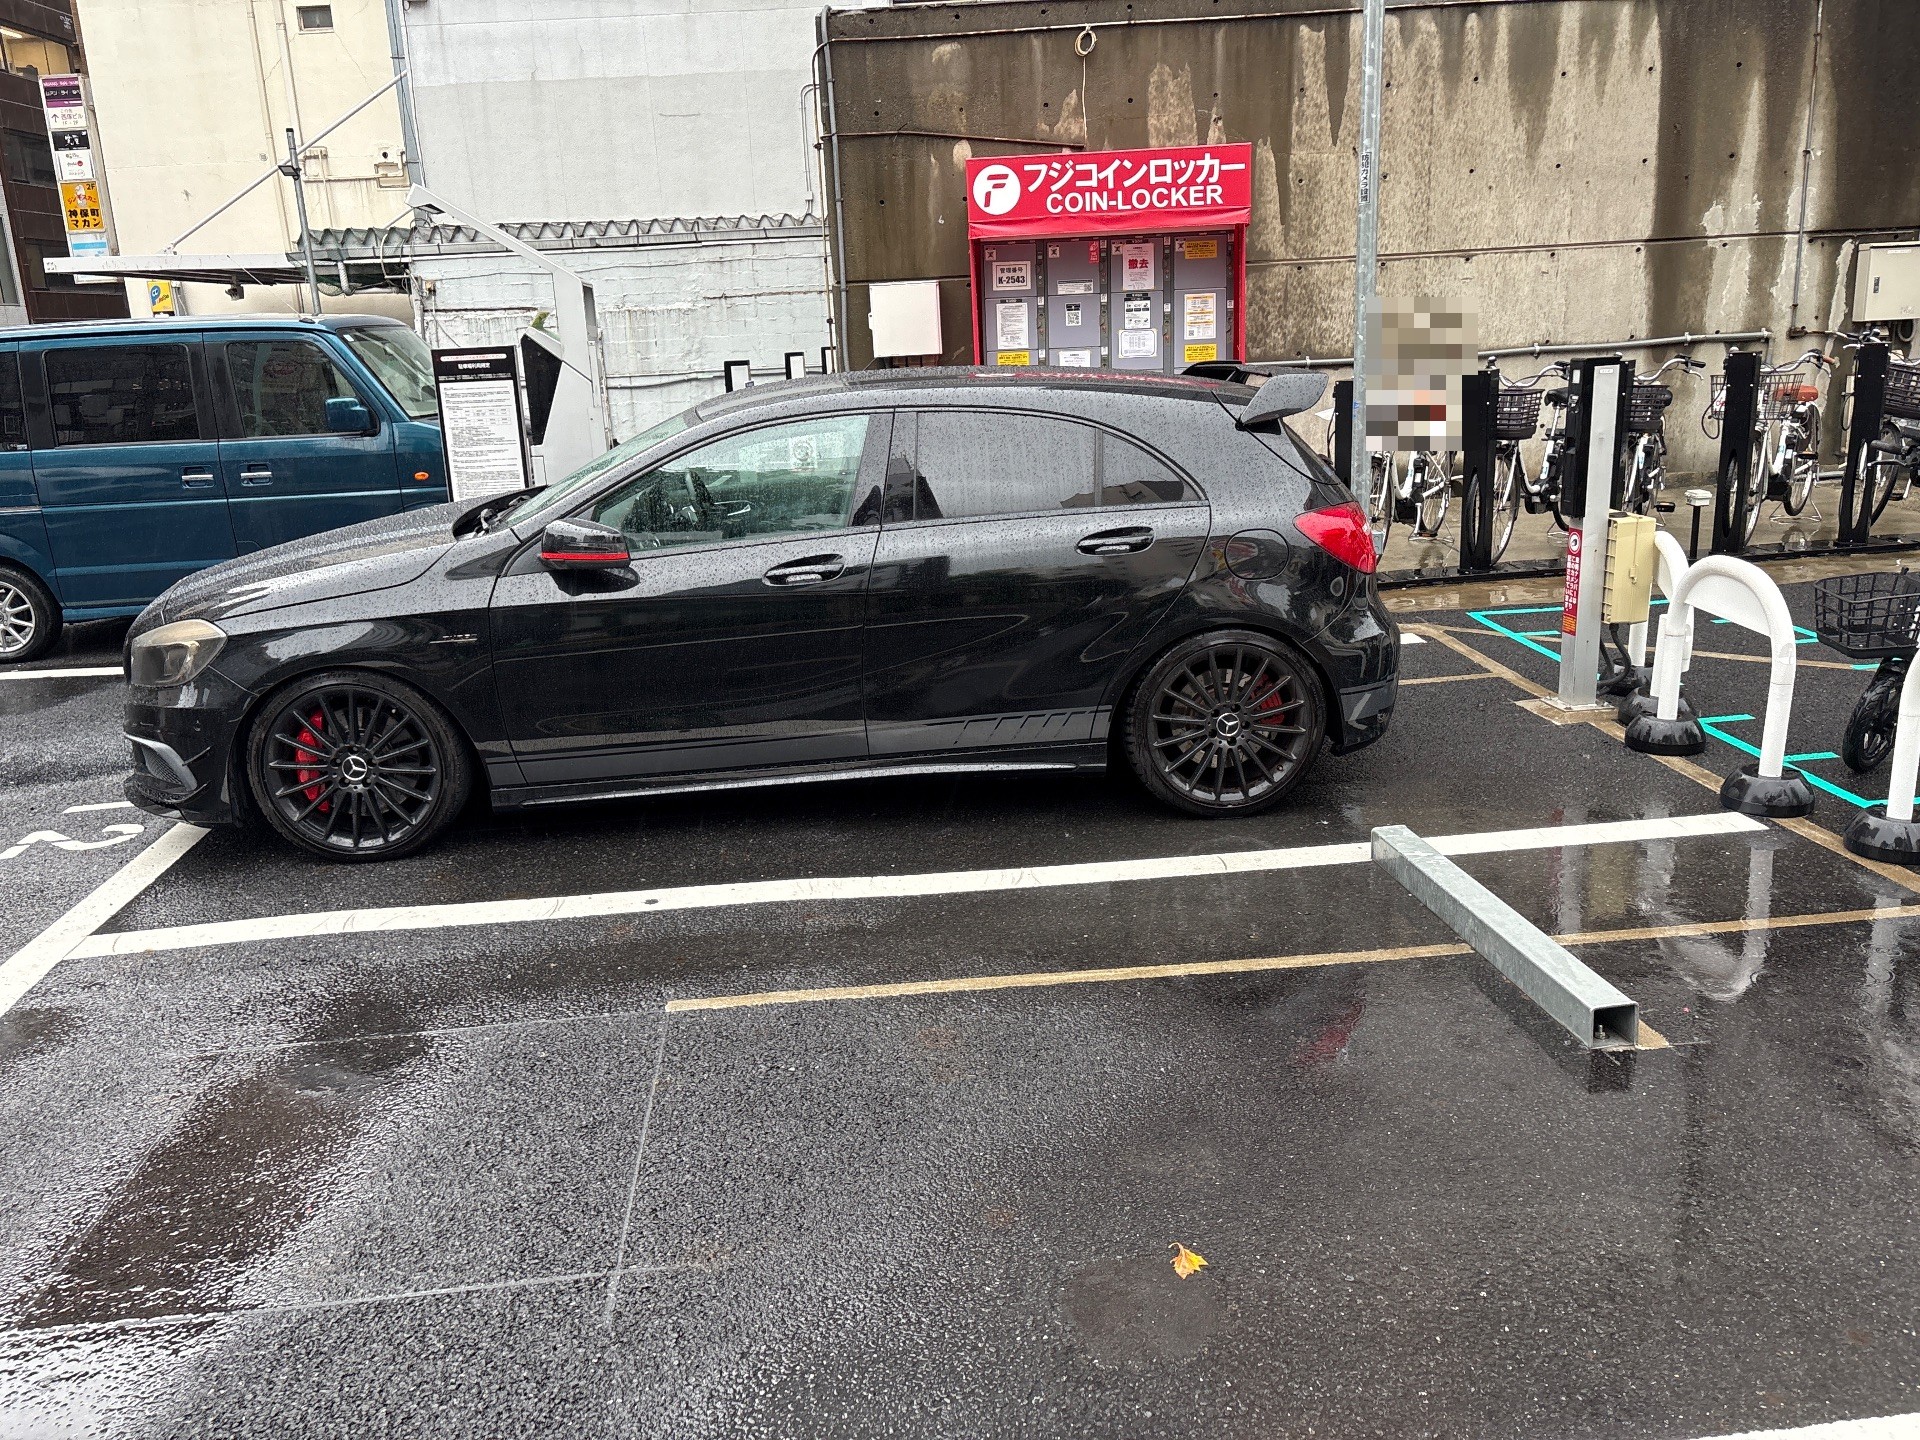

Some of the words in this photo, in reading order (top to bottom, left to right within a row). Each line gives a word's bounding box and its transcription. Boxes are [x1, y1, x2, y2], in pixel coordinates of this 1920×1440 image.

[1022, 152, 1246, 194] フジコインロッカー
[1046, 184, 1223, 214] COIN-LOCKER
[68, 208, 100, 218] 神保町
[71, 218, 101, 228] マカン
[998, 276, 1026, 285] K-2543
